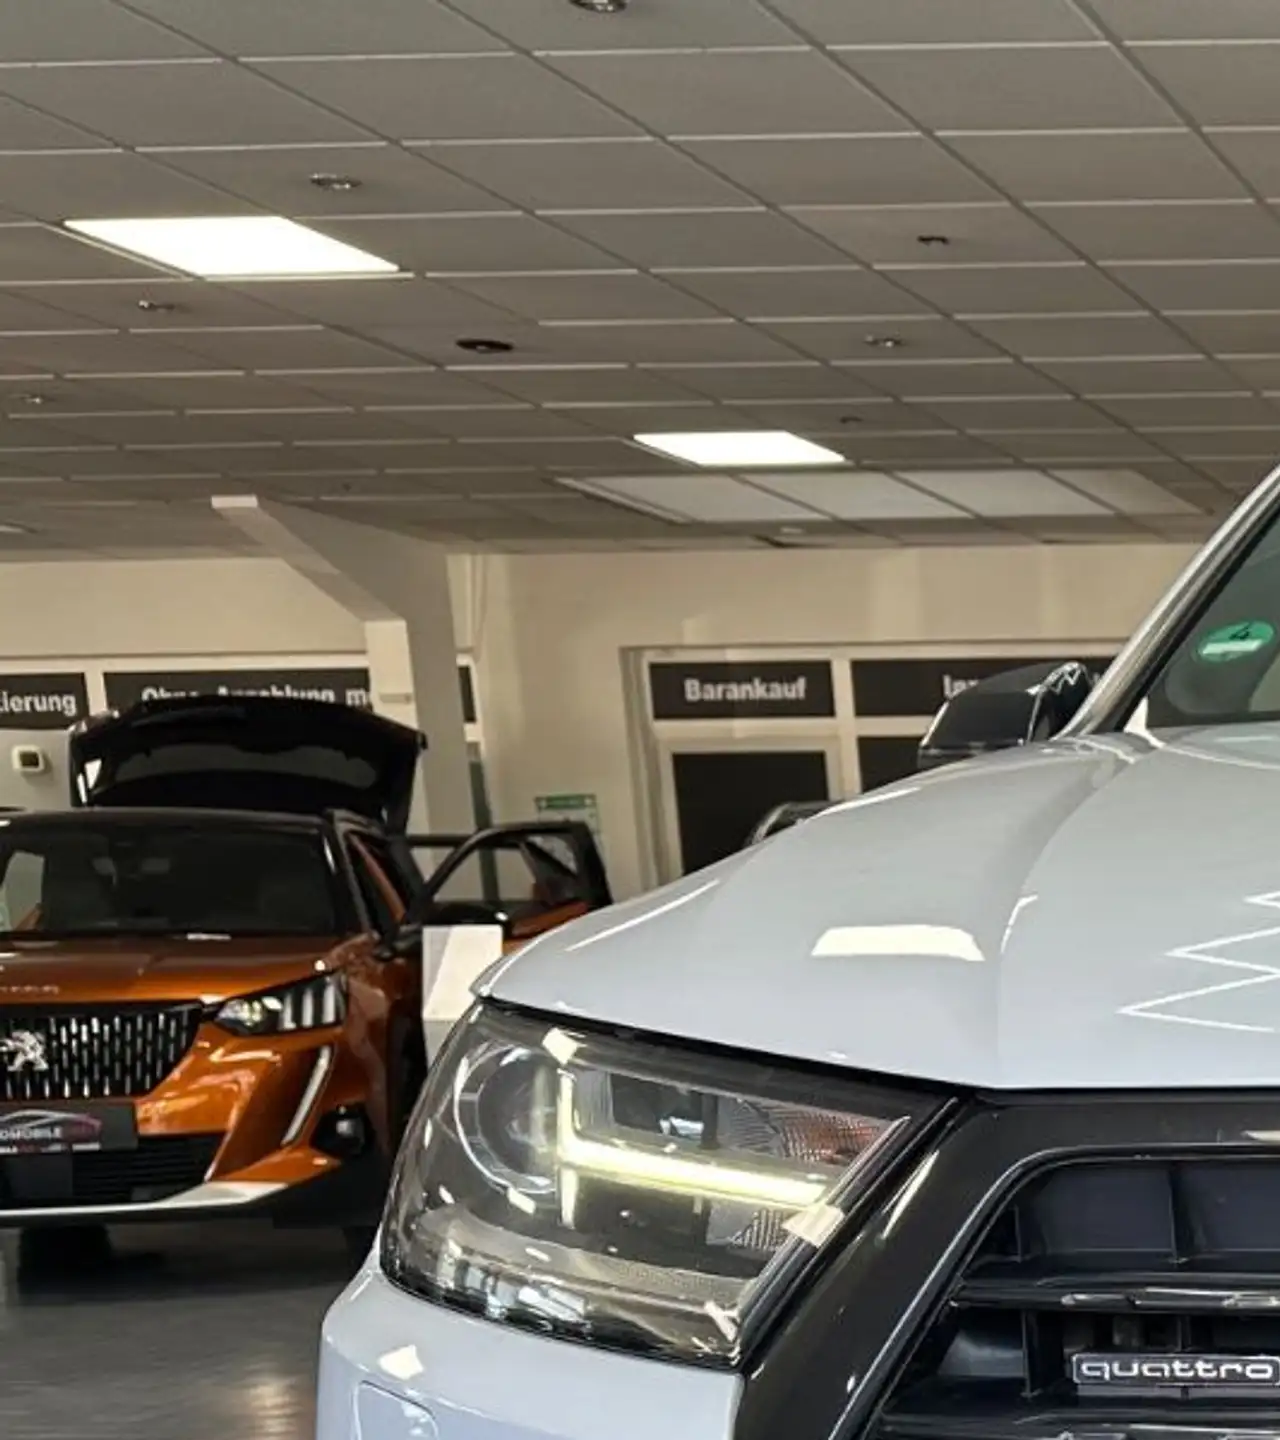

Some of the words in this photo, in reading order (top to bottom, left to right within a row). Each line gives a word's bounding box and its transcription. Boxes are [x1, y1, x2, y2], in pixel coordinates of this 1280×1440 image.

[684, 677, 806, 701] Barankauf
[0, 690, 77, 717] ierung
[1081, 1359, 1274, 1381] quattro
